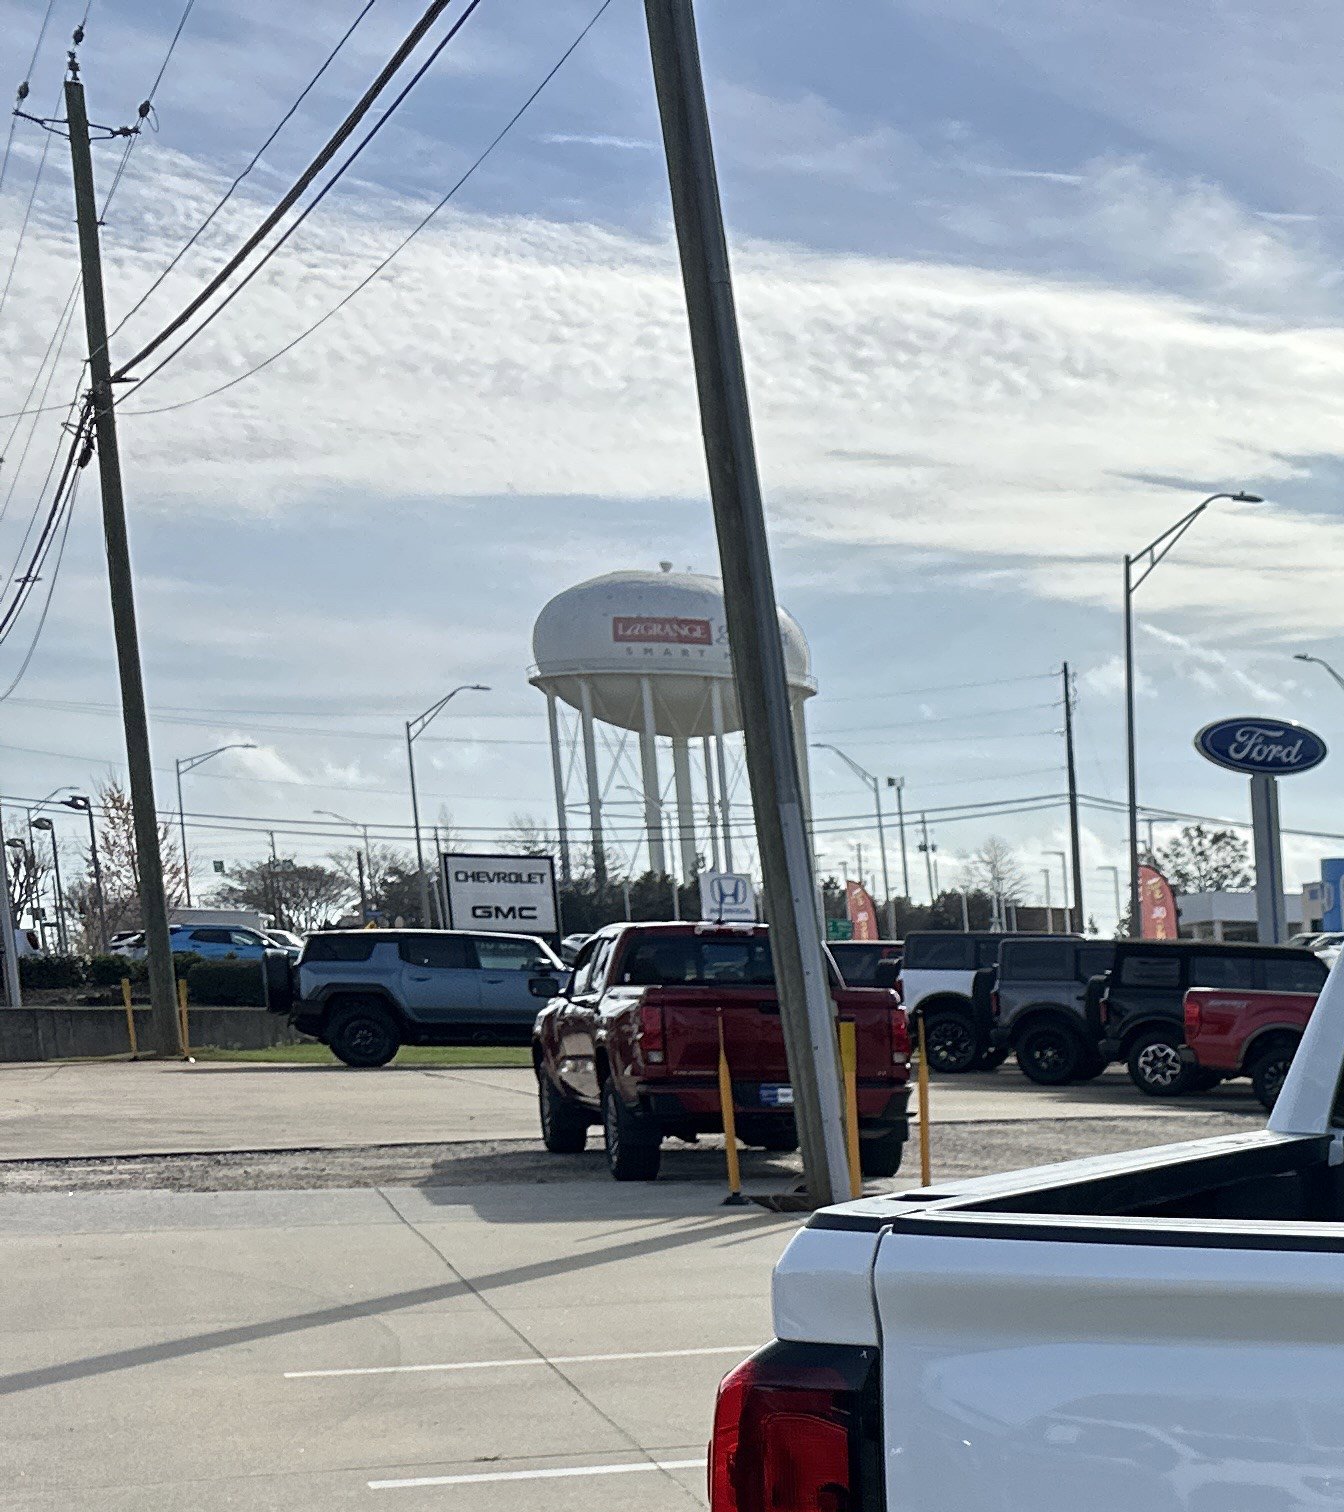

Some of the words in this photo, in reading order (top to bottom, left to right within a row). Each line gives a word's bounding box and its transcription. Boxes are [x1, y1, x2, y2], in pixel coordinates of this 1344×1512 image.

[1228, 726, 1302, 763] Ford
[454, 870, 546, 884] CHEVROLET
[472, 905, 537, 919] GMC
